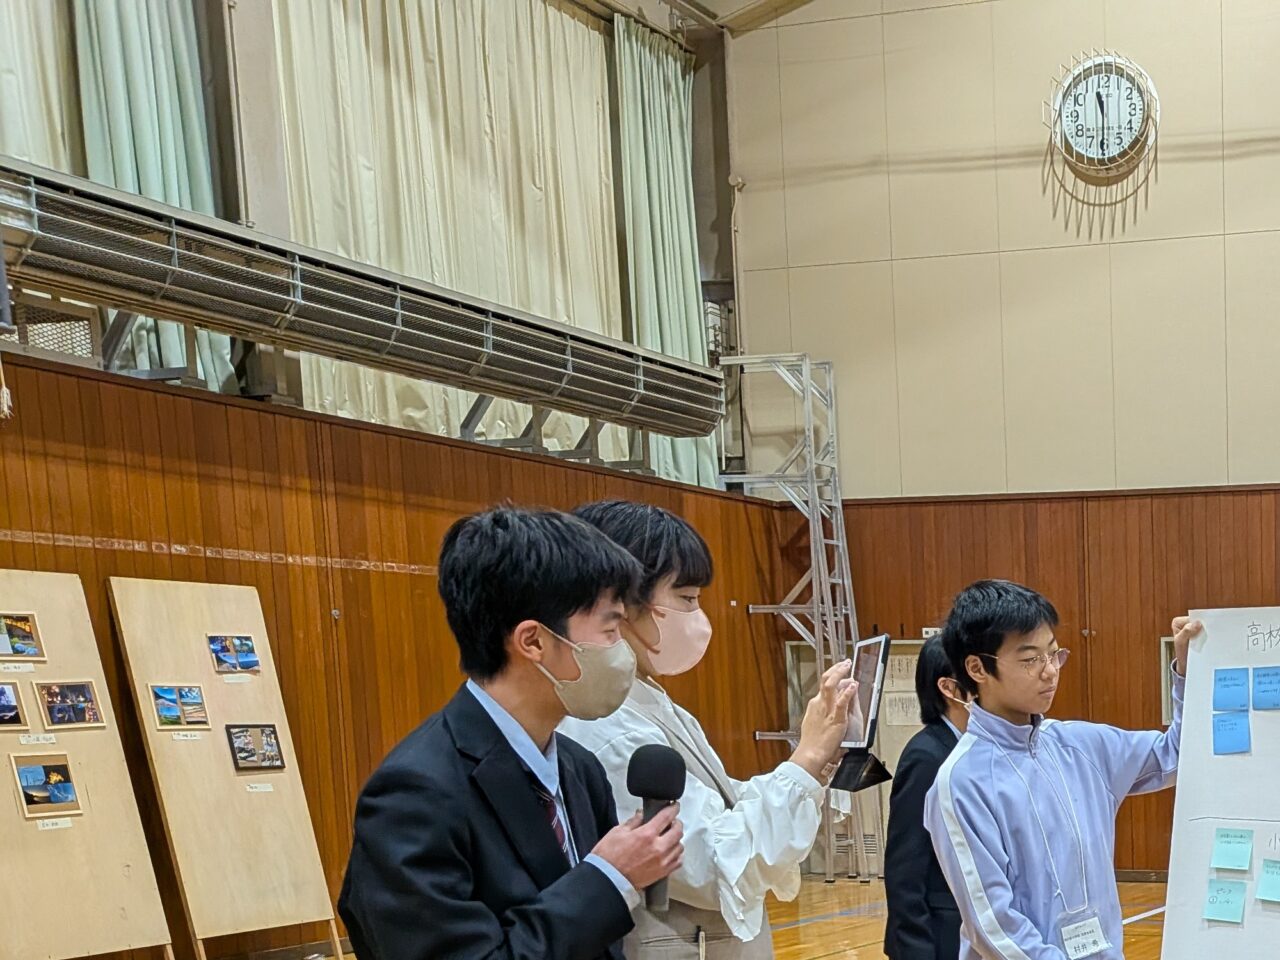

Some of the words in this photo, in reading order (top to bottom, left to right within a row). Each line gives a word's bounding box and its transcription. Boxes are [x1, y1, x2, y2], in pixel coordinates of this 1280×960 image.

[1098, 74, 1110, 89] 12
[1073, 92, 1084, 107] 10
[1125, 86, 1133, 100] 2
[1070, 109, 1080, 124] 9
[1128, 102, 1137, 117] 3
[1075, 123, 1085, 138] 8
[1126, 119, 1134, 133] 4
[1086, 135, 1095, 149] 7
[1114, 132, 1123, 146] 5
